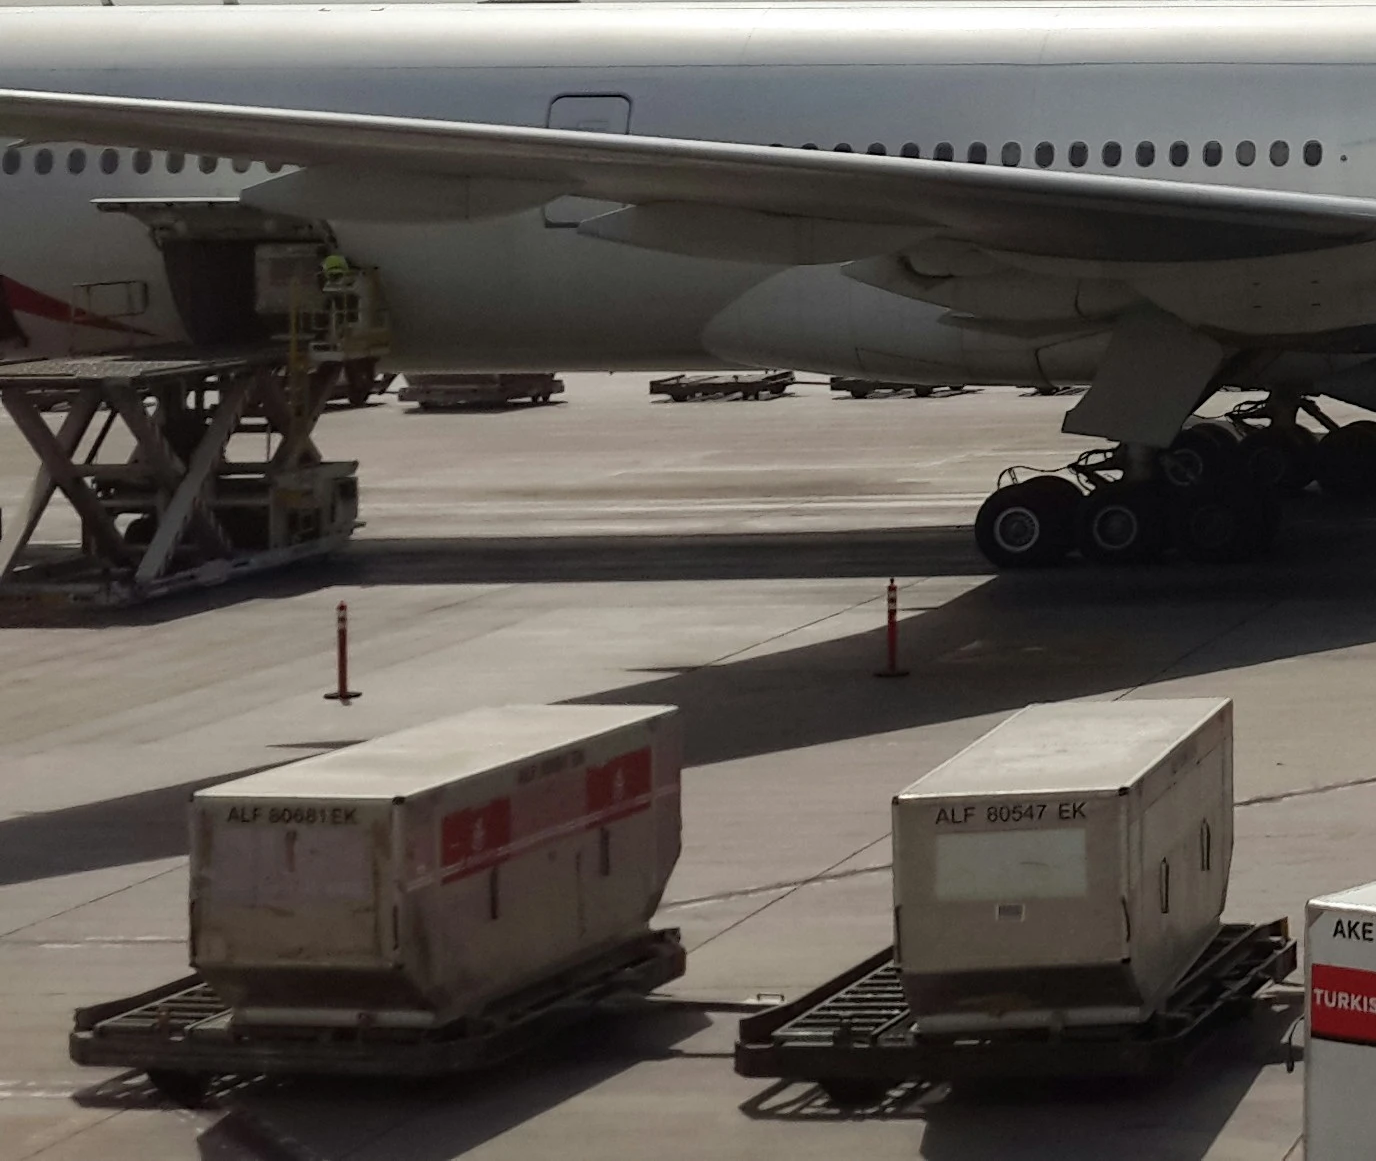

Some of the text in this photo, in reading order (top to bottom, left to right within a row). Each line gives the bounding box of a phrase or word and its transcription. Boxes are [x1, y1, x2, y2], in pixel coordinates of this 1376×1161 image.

[227, 806, 262, 823] ALF
[331, 807, 358, 825] EK
[935, 801, 1087, 825] ALF 80547 EK
[1333, 918, 1374, 942] AKE
